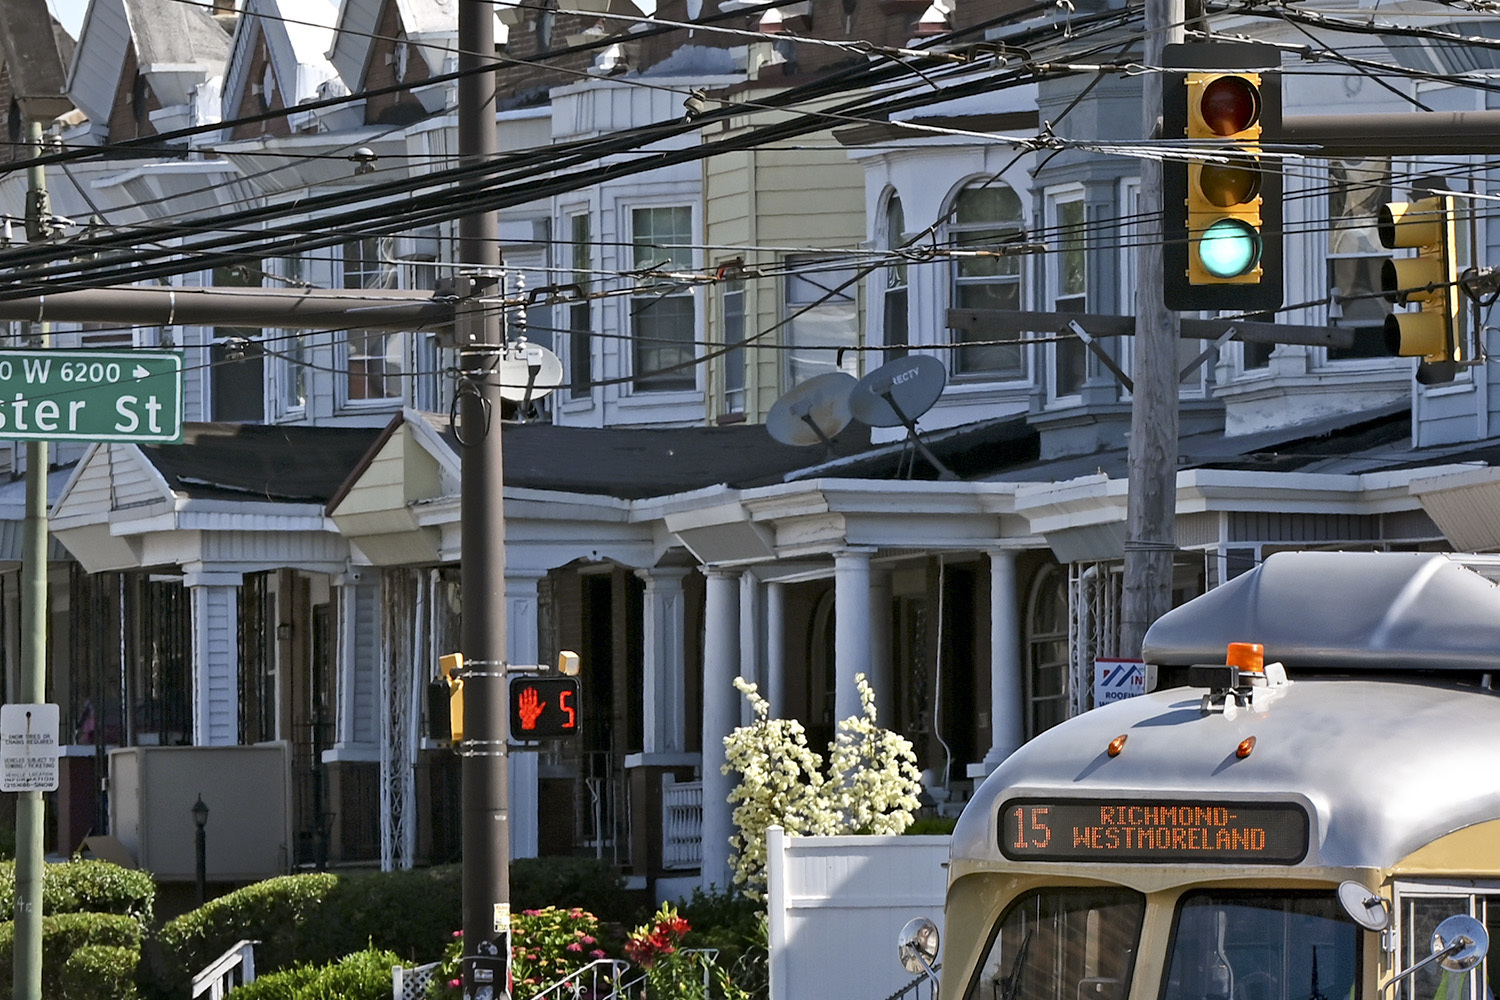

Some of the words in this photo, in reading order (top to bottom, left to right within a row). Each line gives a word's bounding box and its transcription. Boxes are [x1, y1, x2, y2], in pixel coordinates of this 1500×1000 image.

[22, 359, 51, 384] W
[60, 362, 121, 383] 6200
[114, 395, 162, 433] St
[559, 690, 575, 729] 5
[1013, 807, 1052, 849] 15
[1099, 805, 1238, 827] RICHMOND-
[1072, 826, 1266, 851] WESTMORELAND
